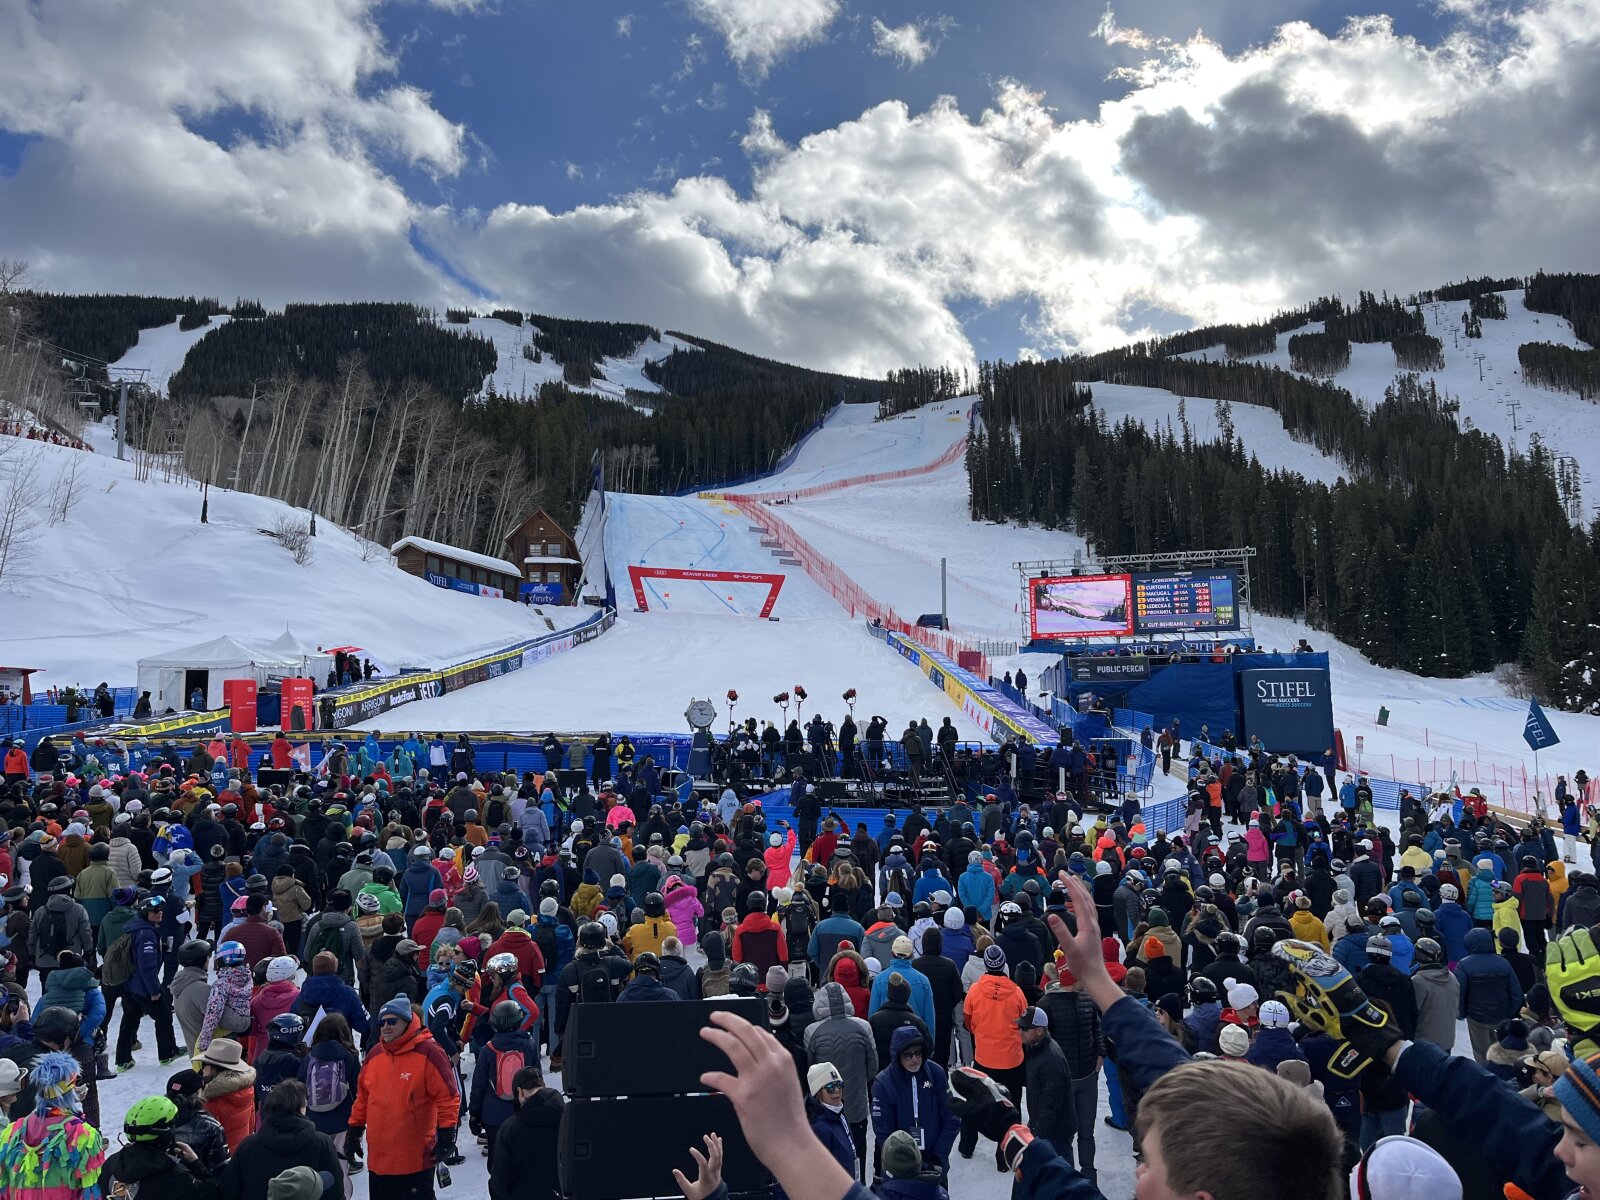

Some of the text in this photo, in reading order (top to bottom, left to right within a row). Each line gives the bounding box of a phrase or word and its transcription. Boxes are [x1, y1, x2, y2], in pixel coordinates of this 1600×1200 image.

[429, 572, 448, 587] STIFEL
[528, 594, 554, 603] xfinity
[489, 663, 503, 678] STIFEL
[1257, 680, 1316, 698] STIFEL
[360, 695, 386, 713] ARRIGONI
[108, 763, 120, 771] USA
[280, 1025, 304, 1034] GIRO
